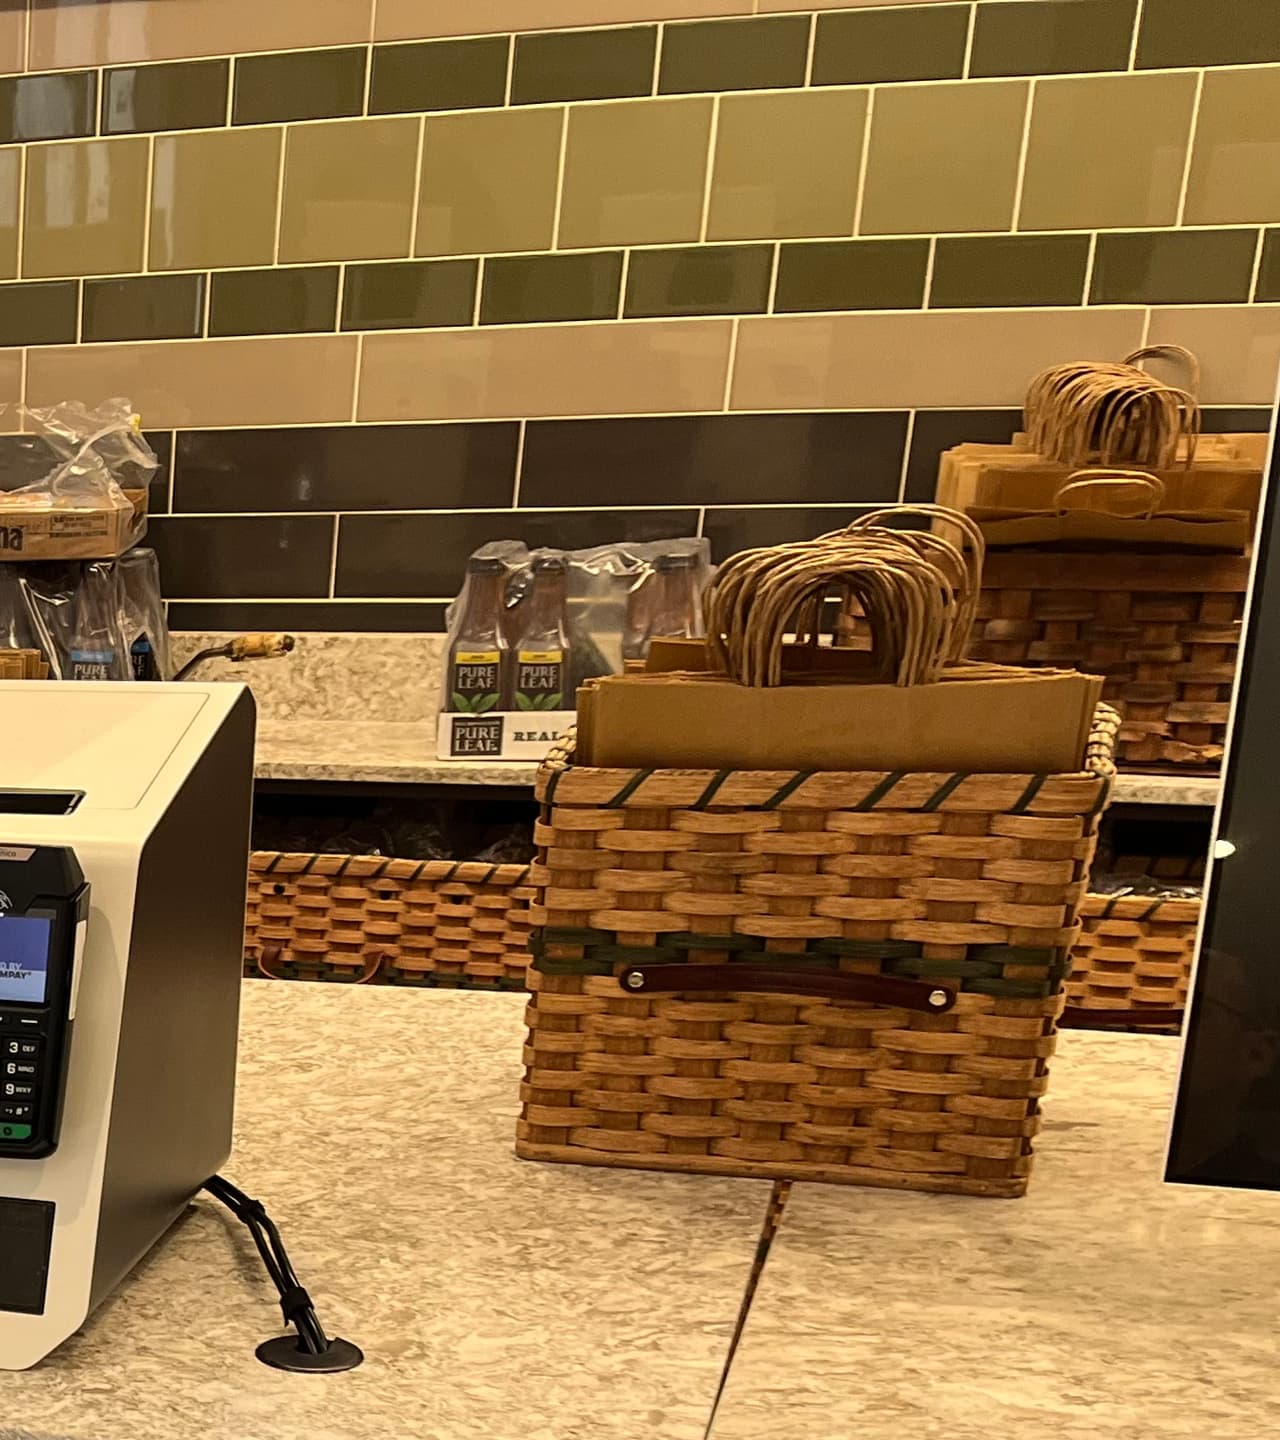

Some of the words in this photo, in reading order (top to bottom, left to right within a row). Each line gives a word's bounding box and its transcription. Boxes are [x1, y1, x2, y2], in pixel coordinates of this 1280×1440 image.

[75, 664, 108, 677] PURE
[459, 666, 495, 677] PURE
[522, 666, 558, 677] PURE
[459, 678, 494, 688] LEAF
[521, 678, 556, 688] LEAF
[455, 727, 499, 739] PURE
[514, 732, 559, 741] REAL
[10, 962, 22, 970] BY
[9, 1042, 18, 1053] 3
[7, 1063, 16, 1074] 6
[6, 1084, 14, 1094] 9
